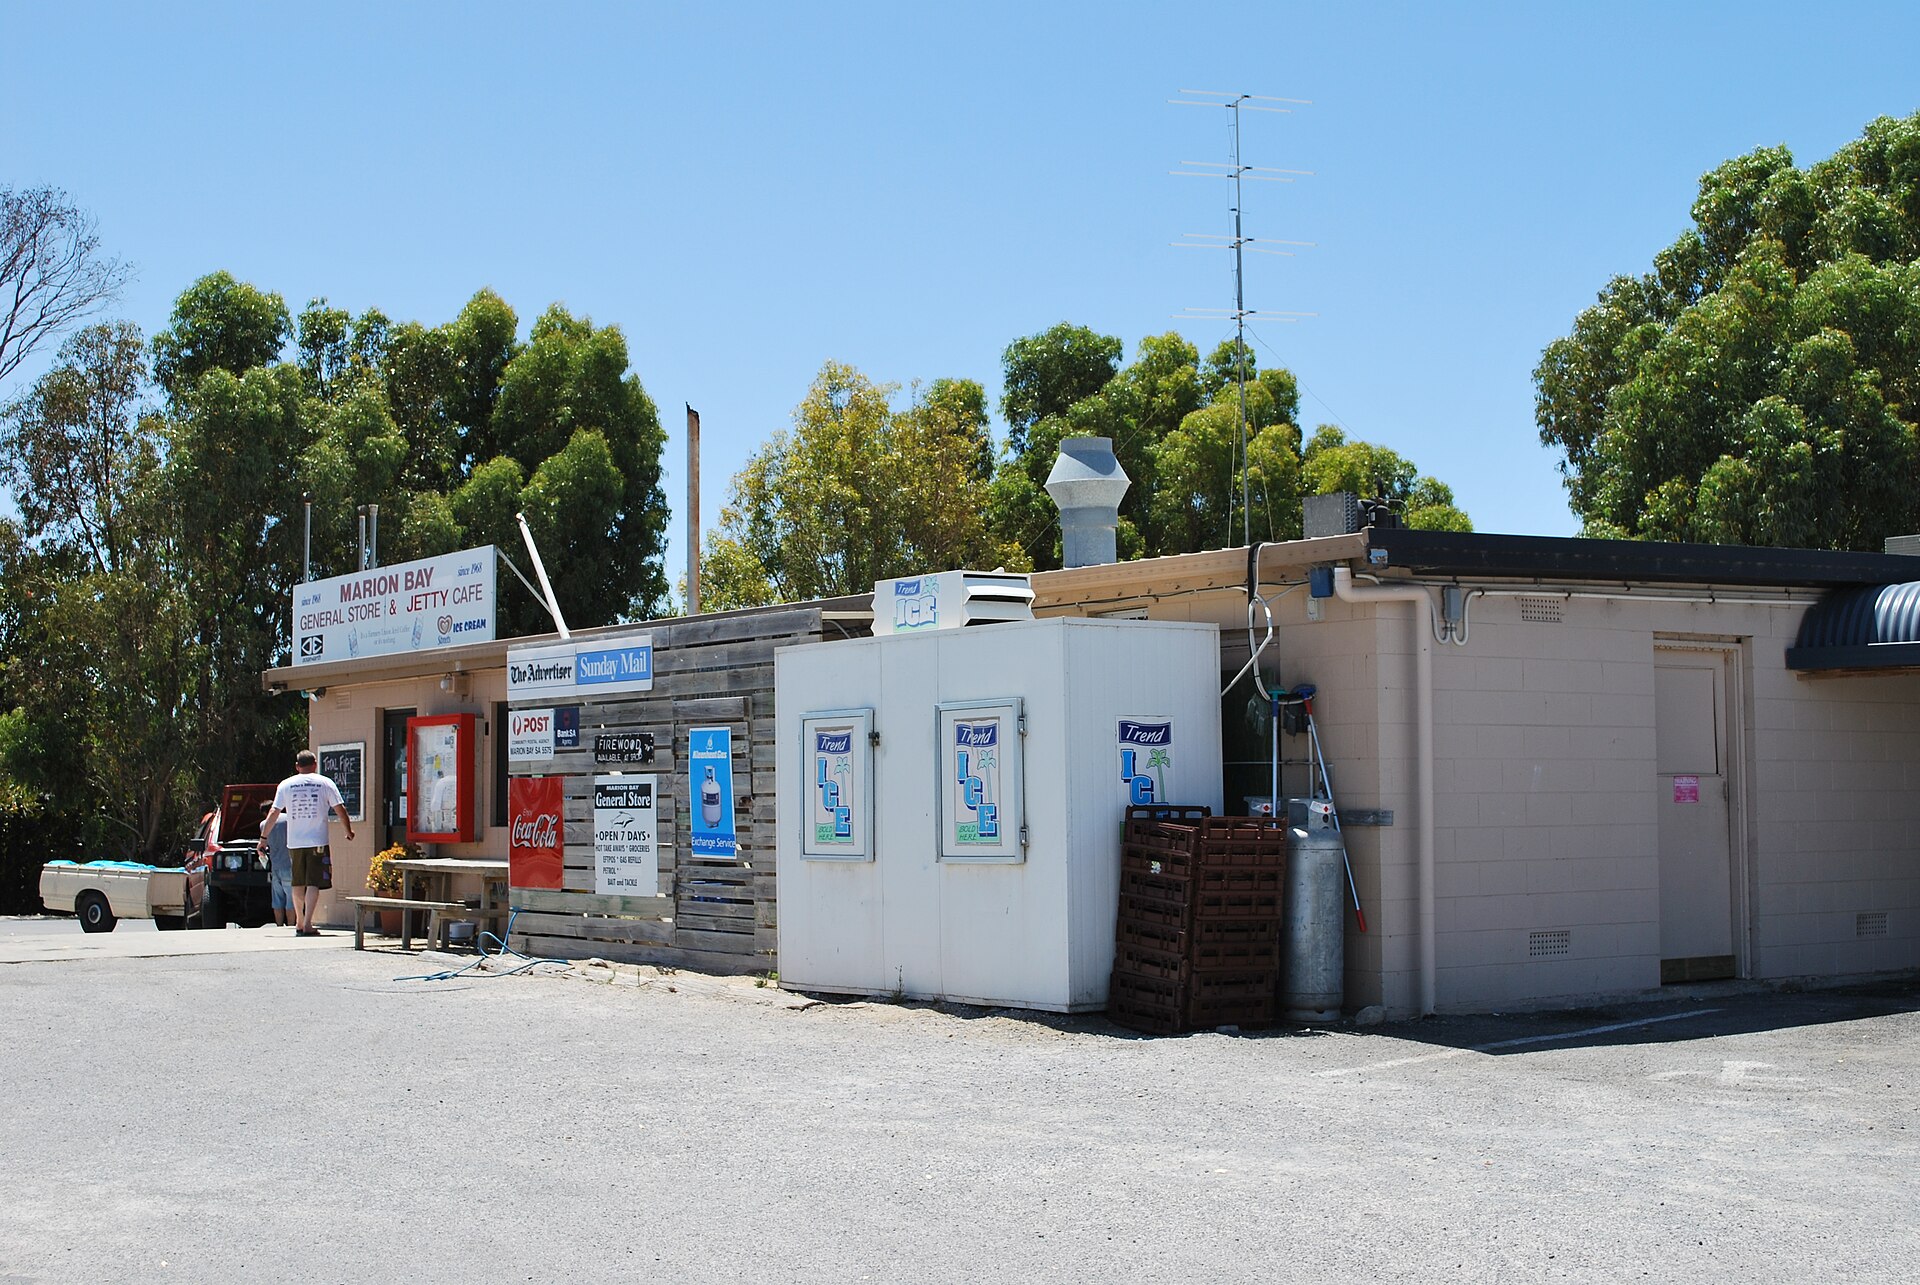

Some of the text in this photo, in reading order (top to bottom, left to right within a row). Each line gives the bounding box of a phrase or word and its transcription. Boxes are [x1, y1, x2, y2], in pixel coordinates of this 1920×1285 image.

[458, 562, 482, 577] since 1968
[340, 566, 434, 602] MARION BAY
[896, 582, 918, 594] Trend
[312, 593, 322, 604] 1968
[300, 583, 483, 630] GENERAL STORE & JETTY CAFE
[895, 596, 937, 627] ICE
[453, 618, 486, 633] ICE CREAM
[580, 651, 646, 680] Sunday Mail
[510, 663, 572, 684] The Advertiser
[524, 716, 550, 732] POST
[557, 729, 576, 738] BankSA
[961, 728, 993, 744] Trend
[1126, 724, 1165, 742] Trend
[510, 747, 526, 755] MARION
[526, 746, 534, 754] BAY
[535, 746, 541, 754] SA
[598, 738, 642, 750] FIREWOOD
[820, 736, 848, 752] Trend
[340, 755, 355, 773] FIRE
[596, 792, 651, 806] General Store
[817, 757, 851, 837] ICE
[956, 750, 999, 837] ICE
[512, 814, 558, 848] Coca-Cola
[599, 831, 646, 841] OPEN 7 DAYS
[959, 825, 976, 833] SOLD
[692, 836, 736, 850] Exchange Service
[602, 856, 616, 864] EFTPOS
[628, 856, 642, 864] REFILLS
[608, 878, 638, 886] BAIT and TACKLE
